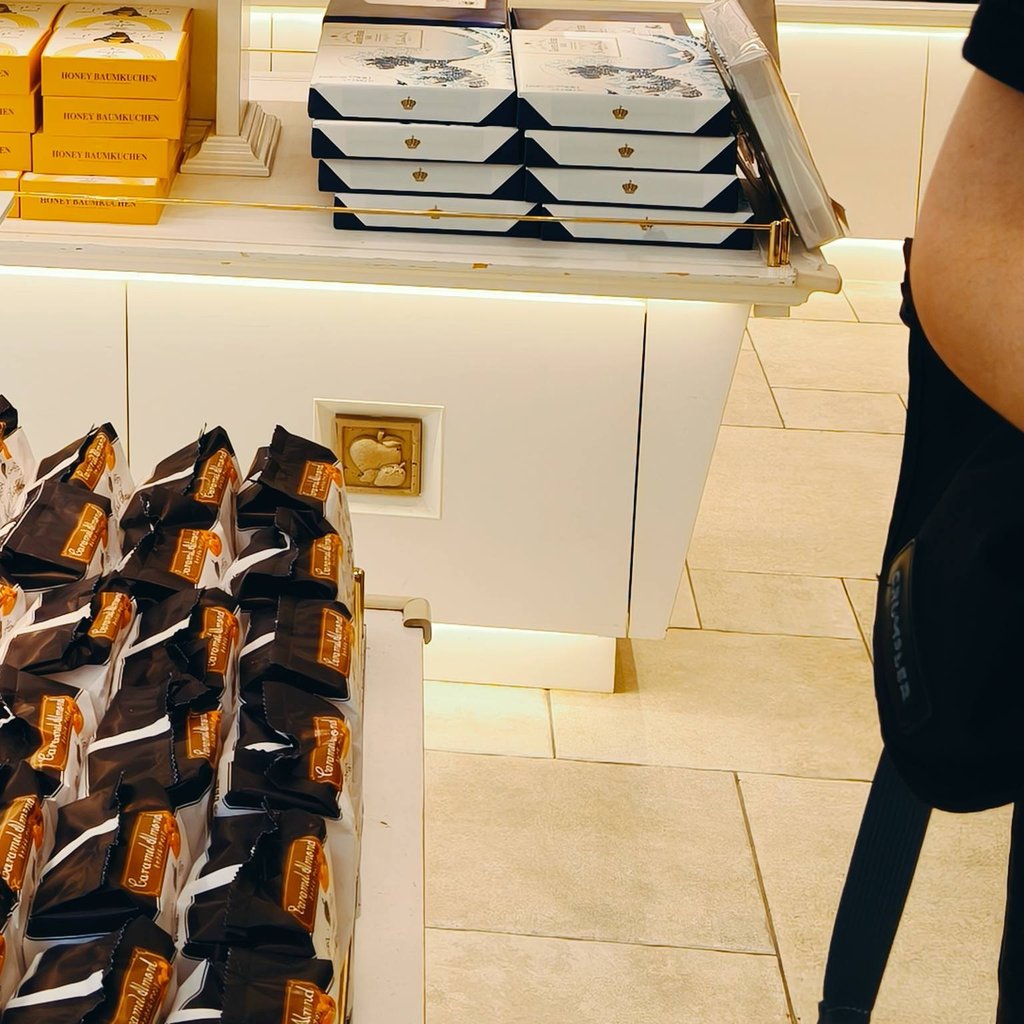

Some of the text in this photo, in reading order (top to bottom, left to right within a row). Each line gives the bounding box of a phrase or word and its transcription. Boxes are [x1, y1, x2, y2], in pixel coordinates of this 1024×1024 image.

[61, 72, 157, 83] HONEY BAUMKUCHEN
[63, 112, 160, 122] HONEY BAUMKUCHEN
[52, 150, 148, 161] HONEY BAUMKUCHEN
